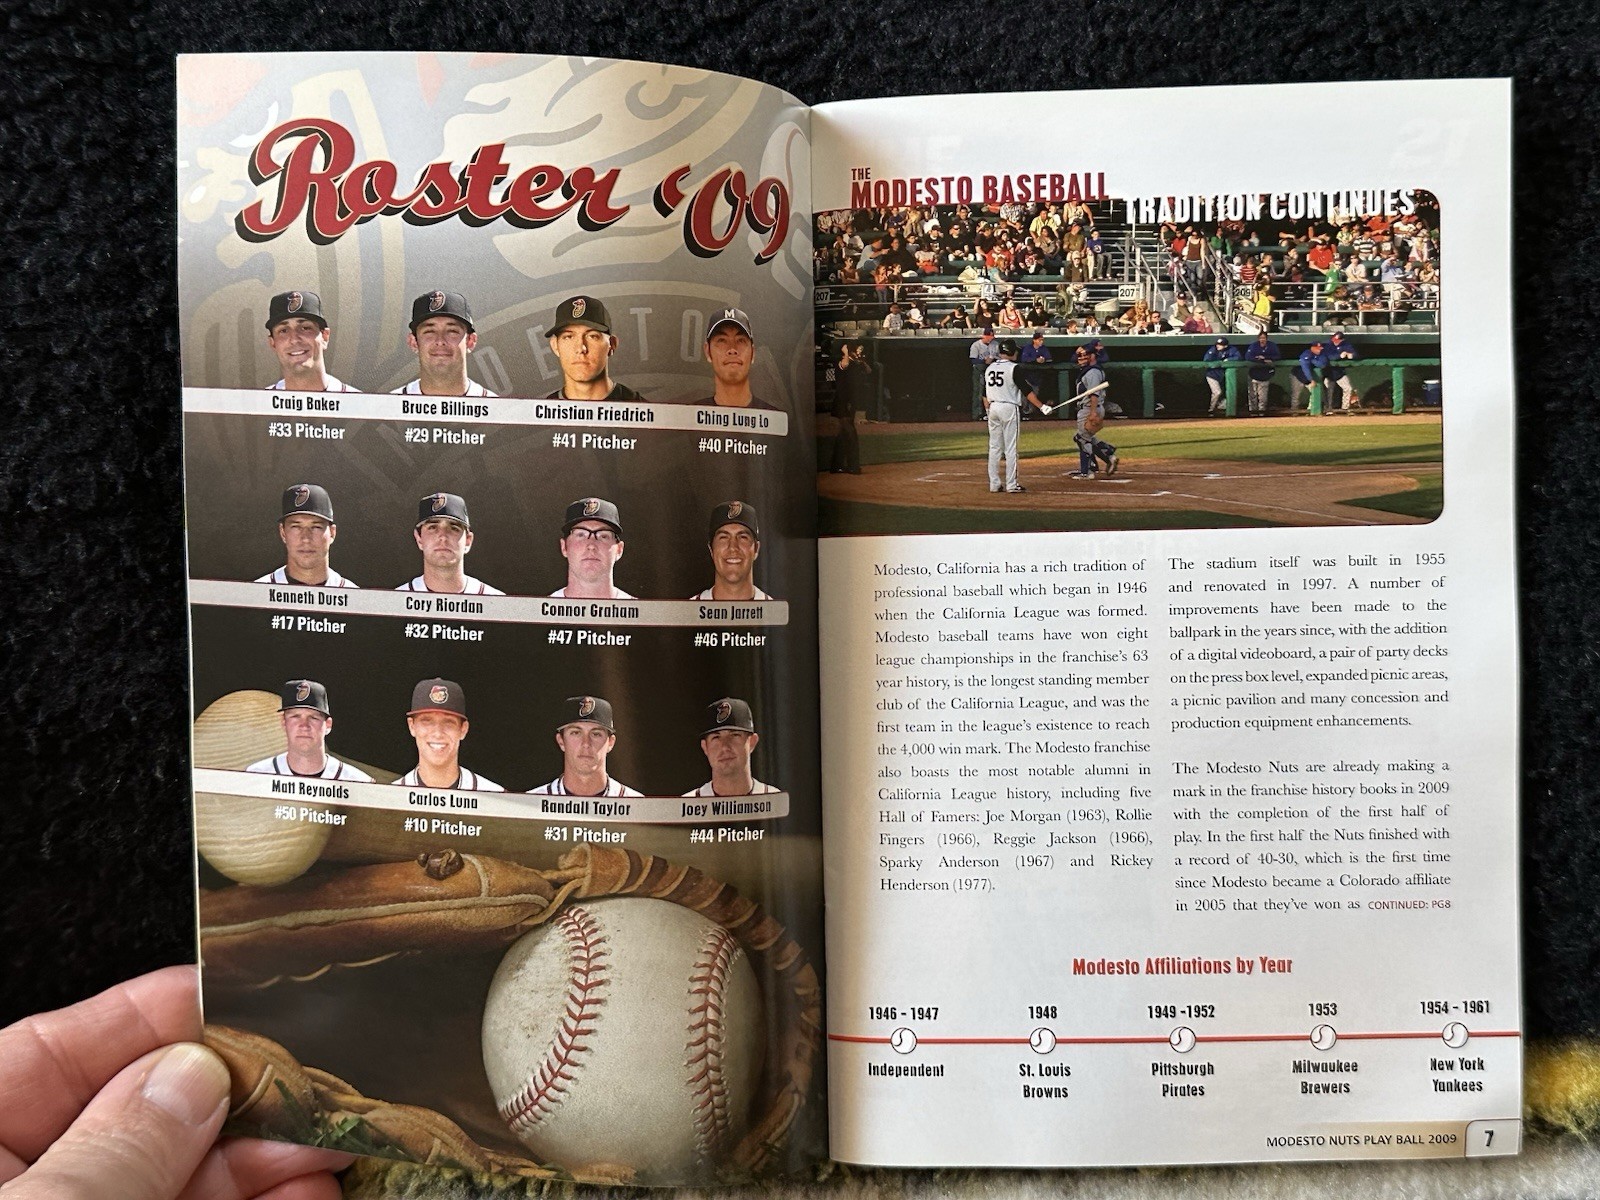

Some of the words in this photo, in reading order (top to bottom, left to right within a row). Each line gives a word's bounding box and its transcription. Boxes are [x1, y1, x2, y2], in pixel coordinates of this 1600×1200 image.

[851, 167, 871, 180] THE
[235, 117, 629, 245] Roster
[653, 163, 791, 266] '09
[851, 176, 973, 209] MODESTO
[983, 172, 1109, 204] BASEBALL
[1124, 193, 1262, 224] TRADITION
[1269, 189, 1416, 220] CONTINUES
[1119, 288, 1135, 297] 207
[723, 308, 736, 319] M
[988, 371, 1004, 387] 35
[272, 395, 302, 411] Craig
[306, 396, 340, 411] Baker
[402, 400, 436, 414] Bruce
[441, 400, 488, 417] Billings
[535, 404, 593, 420] Christian
[597, 406, 653, 422] Friedrich
[697, 410, 729, 426] Ching
[732, 412, 756, 428] Lung
[759, 414, 768, 427] Lo
[268, 422, 292, 437] #33
[295, 422, 345, 439] Pitcher
[404, 427, 429, 443] #29
[432, 428, 485, 444] Pitcher
[552, 432, 575, 448] #41
[582, 433, 637, 449] Pitcher
[698, 437, 721, 452] #40
[725, 438, 767, 455] Pitcher
[874, 563, 931, 577] Modesto,
[936, 562, 1000, 574] California
[1005, 561, 1025, 573] has
[1030, 564, 1038, 572] a
[1043, 560, 1067, 572] rich
[1073, 559, 1126, 571] tradition
[1132, 558, 1146, 570] of
[1167, 557, 1194, 569] The
[1206, 557, 1256, 569] stadium
[1269, 555, 1300, 567] itself
[1312, 558, 1336, 566] was
[1348, 554, 1377, 566] built
[1389, 554, 1401, 565] in
[1416, 552, 1445, 564] 1955
[269, 588, 314, 604] Kenneth
[318, 591, 348, 606] Durst
[874, 585, 946, 601] professional
[953, 584, 1003, 596] baseball
[1009, 583, 1046, 595] which
[1052, 583, 1090, 598] began
[1097, 582, 1109, 593] in
[1117, 581, 1147, 593] 1946
[406, 596, 432, 612] Cory
[436, 597, 482, 613] Riordan
[541, 602, 586, 617] Connor
[590, 603, 638, 618] Graham
[699, 605, 727, 619] Sean
[730, 605, 762, 620] Jarrett
[874, 608, 907, 620] when
[916, 608, 934, 619] the
[942, 606, 1006, 619] California
[1013, 606, 1059, 621] League
[1098, 604, 1147, 616] formed.
[271, 615, 294, 630] #17
[297, 616, 346, 633] Pitcher
[404, 623, 428, 638] #32
[432, 624, 484, 641] Pitcher
[547, 629, 572, 644] #47
[577, 630, 631, 645] Pitcher
[694, 632, 718, 646] #46
[721, 632, 766, 646] Pitcher
[875, 630, 929, 642] Modesto
[938, 629, 988, 642] baseball
[997, 632, 1034, 641] teams
[1043, 628, 1071, 640] have
[1080, 631, 1107, 639] won
[1116, 626, 1148, 642] eight
[1171, 716, 1240, 732] production
[1244, 715, 1313, 731] equipment
[1316, 714, 1411, 726] enhancements.
[1171, 762, 1199, 774] The
[1206, 761, 1261, 773] Modesto
[1268, 760, 1298, 772] Nuts
[1305, 764, 1325, 772] are
[1332, 759, 1379, 774] already
[1387, 759, 1435, 774] making
[1441, 762, 1449, 770] a
[271, 779, 295, 794] Matt
[298, 782, 349, 798] Reynolds
[409, 791, 446, 806] Carlos
[450, 794, 477, 808] Luna
[541, 799, 588, 814] Randall
[592, 801, 630, 816] Taylor
[274, 806, 296, 820] #50
[300, 807, 347, 825] Pitcher
[681, 802, 707, 817] Joey
[711, 800, 770, 815] Williamson
[404, 817, 428, 832] #10
[431, 819, 482, 836] Pitcher
[544, 826, 567, 840] #31
[573, 827, 626, 842] Pitcher
[690, 828, 714, 843] #44
[718, 826, 764, 842] Pitcher
[879, 855, 922, 871] Sparky
[938, 855, 998, 867] Anderson
[1015, 854, 1054, 870] (1967)
[1070, 854, 1094, 866] and
[1110, 854, 1153, 869] Rickey
[880, 878, 949, 890] Henderson
[953, 878, 995, 892] (1977).
[1176, 899, 1188, 911] in
[1194, 898, 1226, 911] 2005
[1232, 898, 1258, 910] that
[1264, 898, 1307, 913] they've
[1313, 901, 1341, 909] won
[1347, 900, 1360, 909] as
[1367, 900, 1428, 909] CONTINUED:
[1431, 899, 1450, 908] PG8
[1073, 958, 1139, 975] Modesto
[1145, 956, 1231, 974] Affiliations
[1236, 956, 1254, 975] by
[1259, 956, 1292, 973] Year
[869, 1006, 896, 1019] 1946
[910, 1007, 938, 1020] 1947
[1028, 1005, 1057, 1018] 1948
[1148, 1005, 1176, 1018] 1949
[1308, 1002, 1337, 1015] 1953
[1420, 1001, 1448, 1014] 1954
[1462, 1000, 1489, 1013] 1961
[868, 1062, 943, 1077] Independent
[1019, 1063, 1034, 1076] St.
[1038, 1062, 1071, 1076] Louis
[1151, 1062, 1214, 1076] Pittsburgh
[1292, 1059, 1358, 1073] Milwaukee
[1430, 1058, 1454, 1070] New
[1458, 1057, 1484, 1070] York
[1023, 1084, 1068, 1098] Browns
[1162, 1083, 1204, 1097] Pirates
[1301, 1081, 1350, 1094] Brewers
[1432, 1078, 1483, 1092] Yankees
[1266, 1136, 1325, 1147] MODESTO
[1329, 1135, 1360, 1145] NUTS
[1364, 1135, 1392, 1144] PLAY
[1396, 1134, 1424, 1144] BALL
[1428, 1134, 1456, 1144] 2009
[1484, 1130, 1494, 1146] 7
